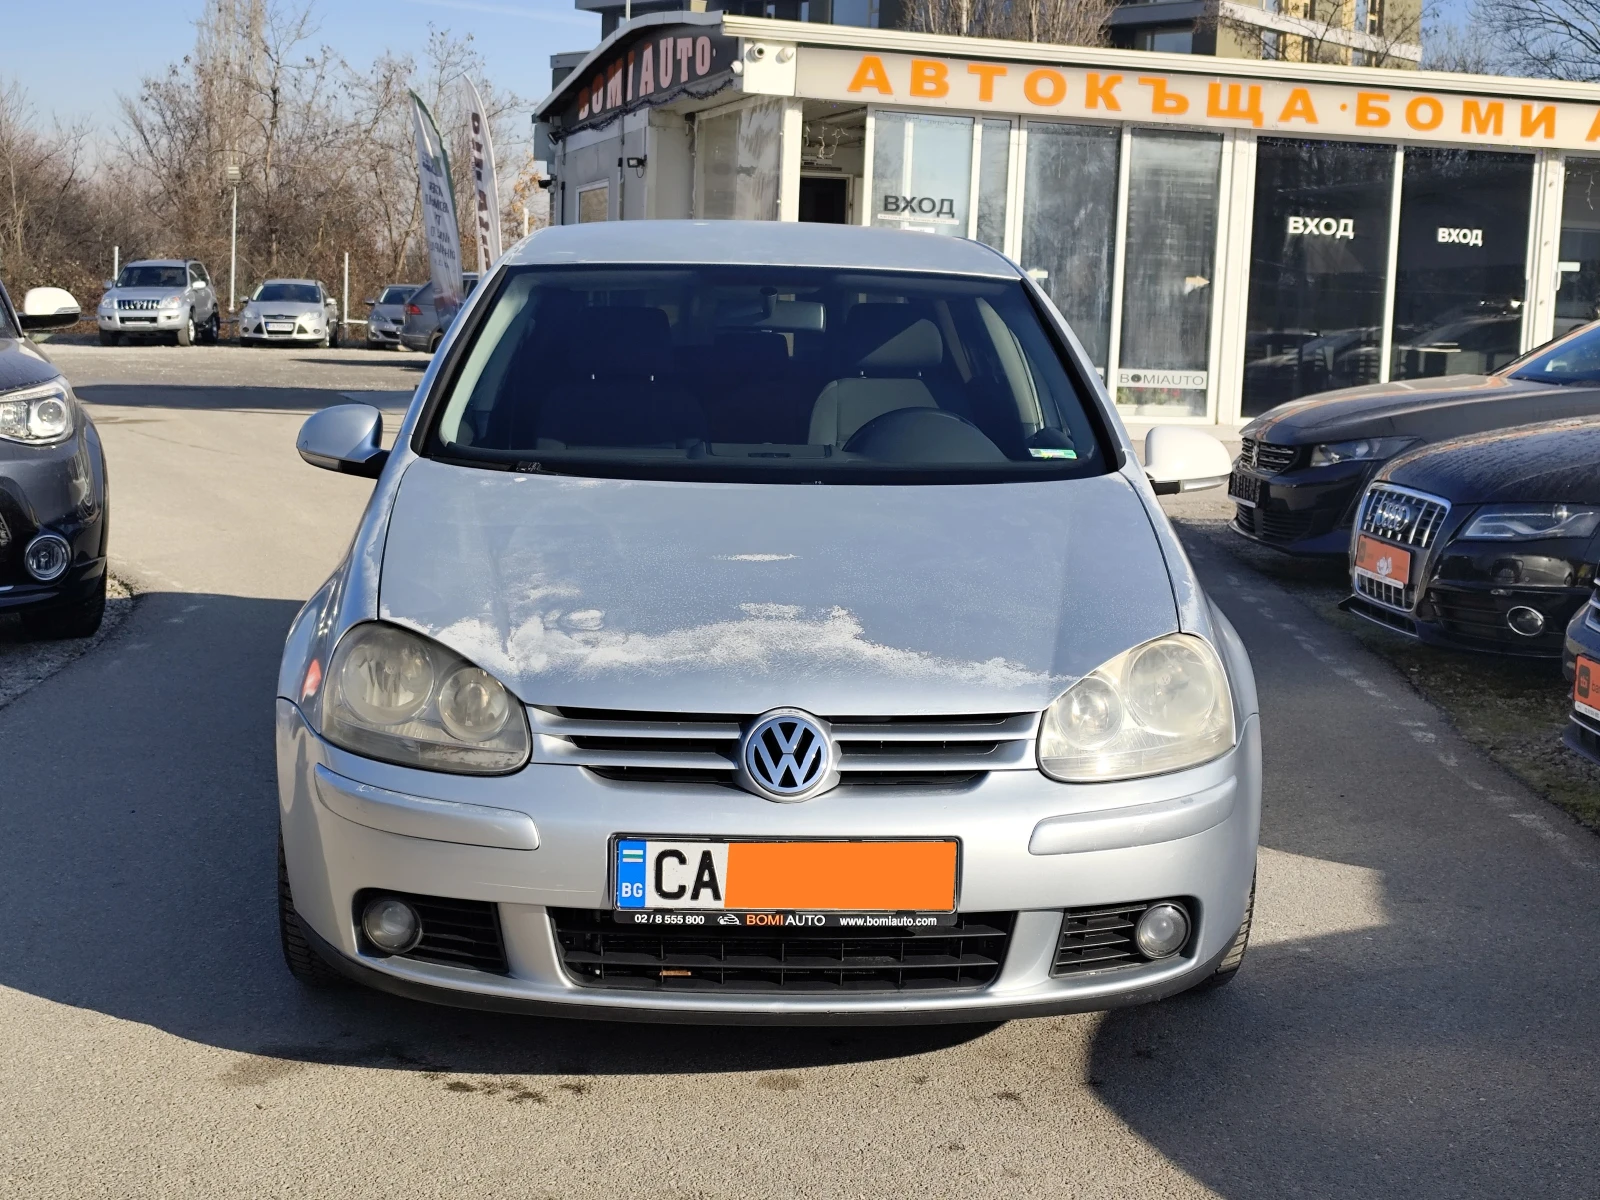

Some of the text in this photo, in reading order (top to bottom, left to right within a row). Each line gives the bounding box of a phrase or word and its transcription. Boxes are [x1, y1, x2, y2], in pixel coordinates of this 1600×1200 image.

[847, 55, 1319, 128] АВТОКЪЩА
[1354, 91, 1557, 140] БОМИ
[884, 195, 955, 218] ВХОД
[1287, 216, 1355, 239] ВХОД
[1437, 228, 1483, 247] ВХОД
[654, 848, 723, 902] CA
[621, 882, 644, 899] BG
[634, 914, 648, 924] 02
[664, 914, 684, 925] 555
[685, 915, 705, 925] 800
[839, 915, 937, 927] www.bomiauto.com
